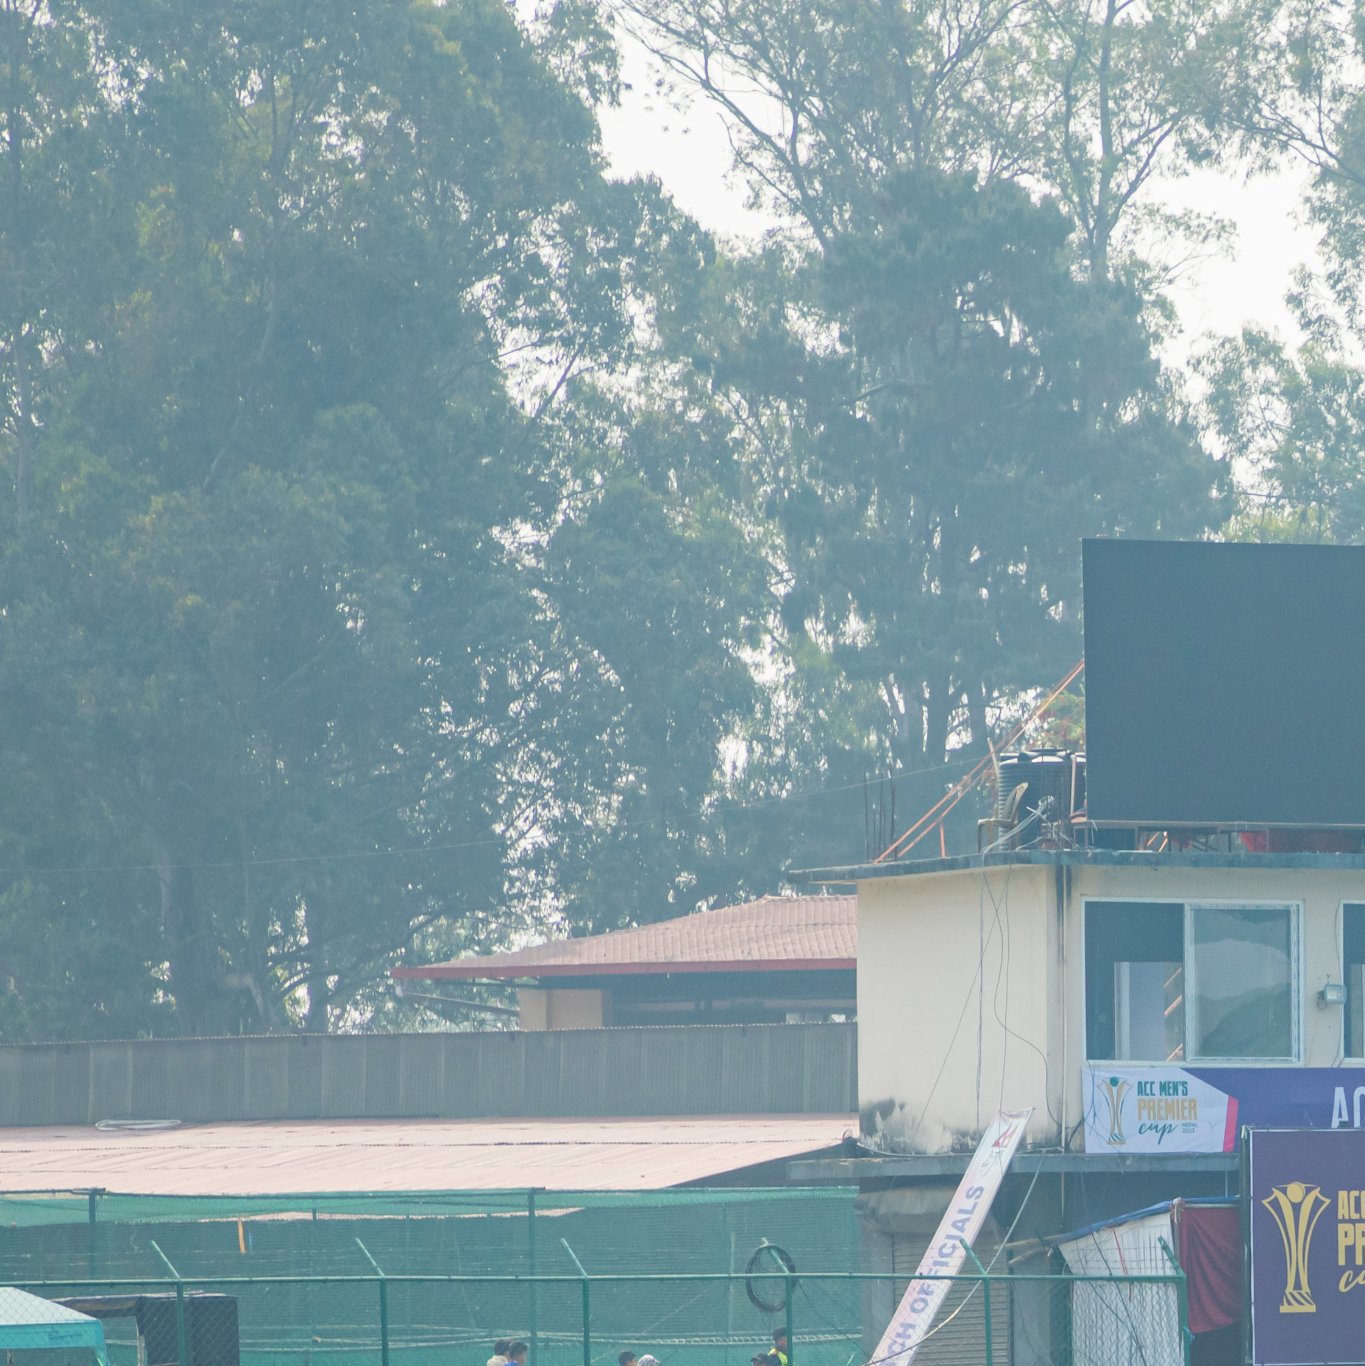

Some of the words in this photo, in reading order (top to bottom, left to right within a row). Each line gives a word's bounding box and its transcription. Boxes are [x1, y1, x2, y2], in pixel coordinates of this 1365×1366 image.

[1137, 1081, 1155, 1096] ACC
[1160, 1081, 1188, 1096] MEN'S
[1137, 1098, 1198, 1121] PREMIER
[1138, 1122, 1179, 1145] cup
